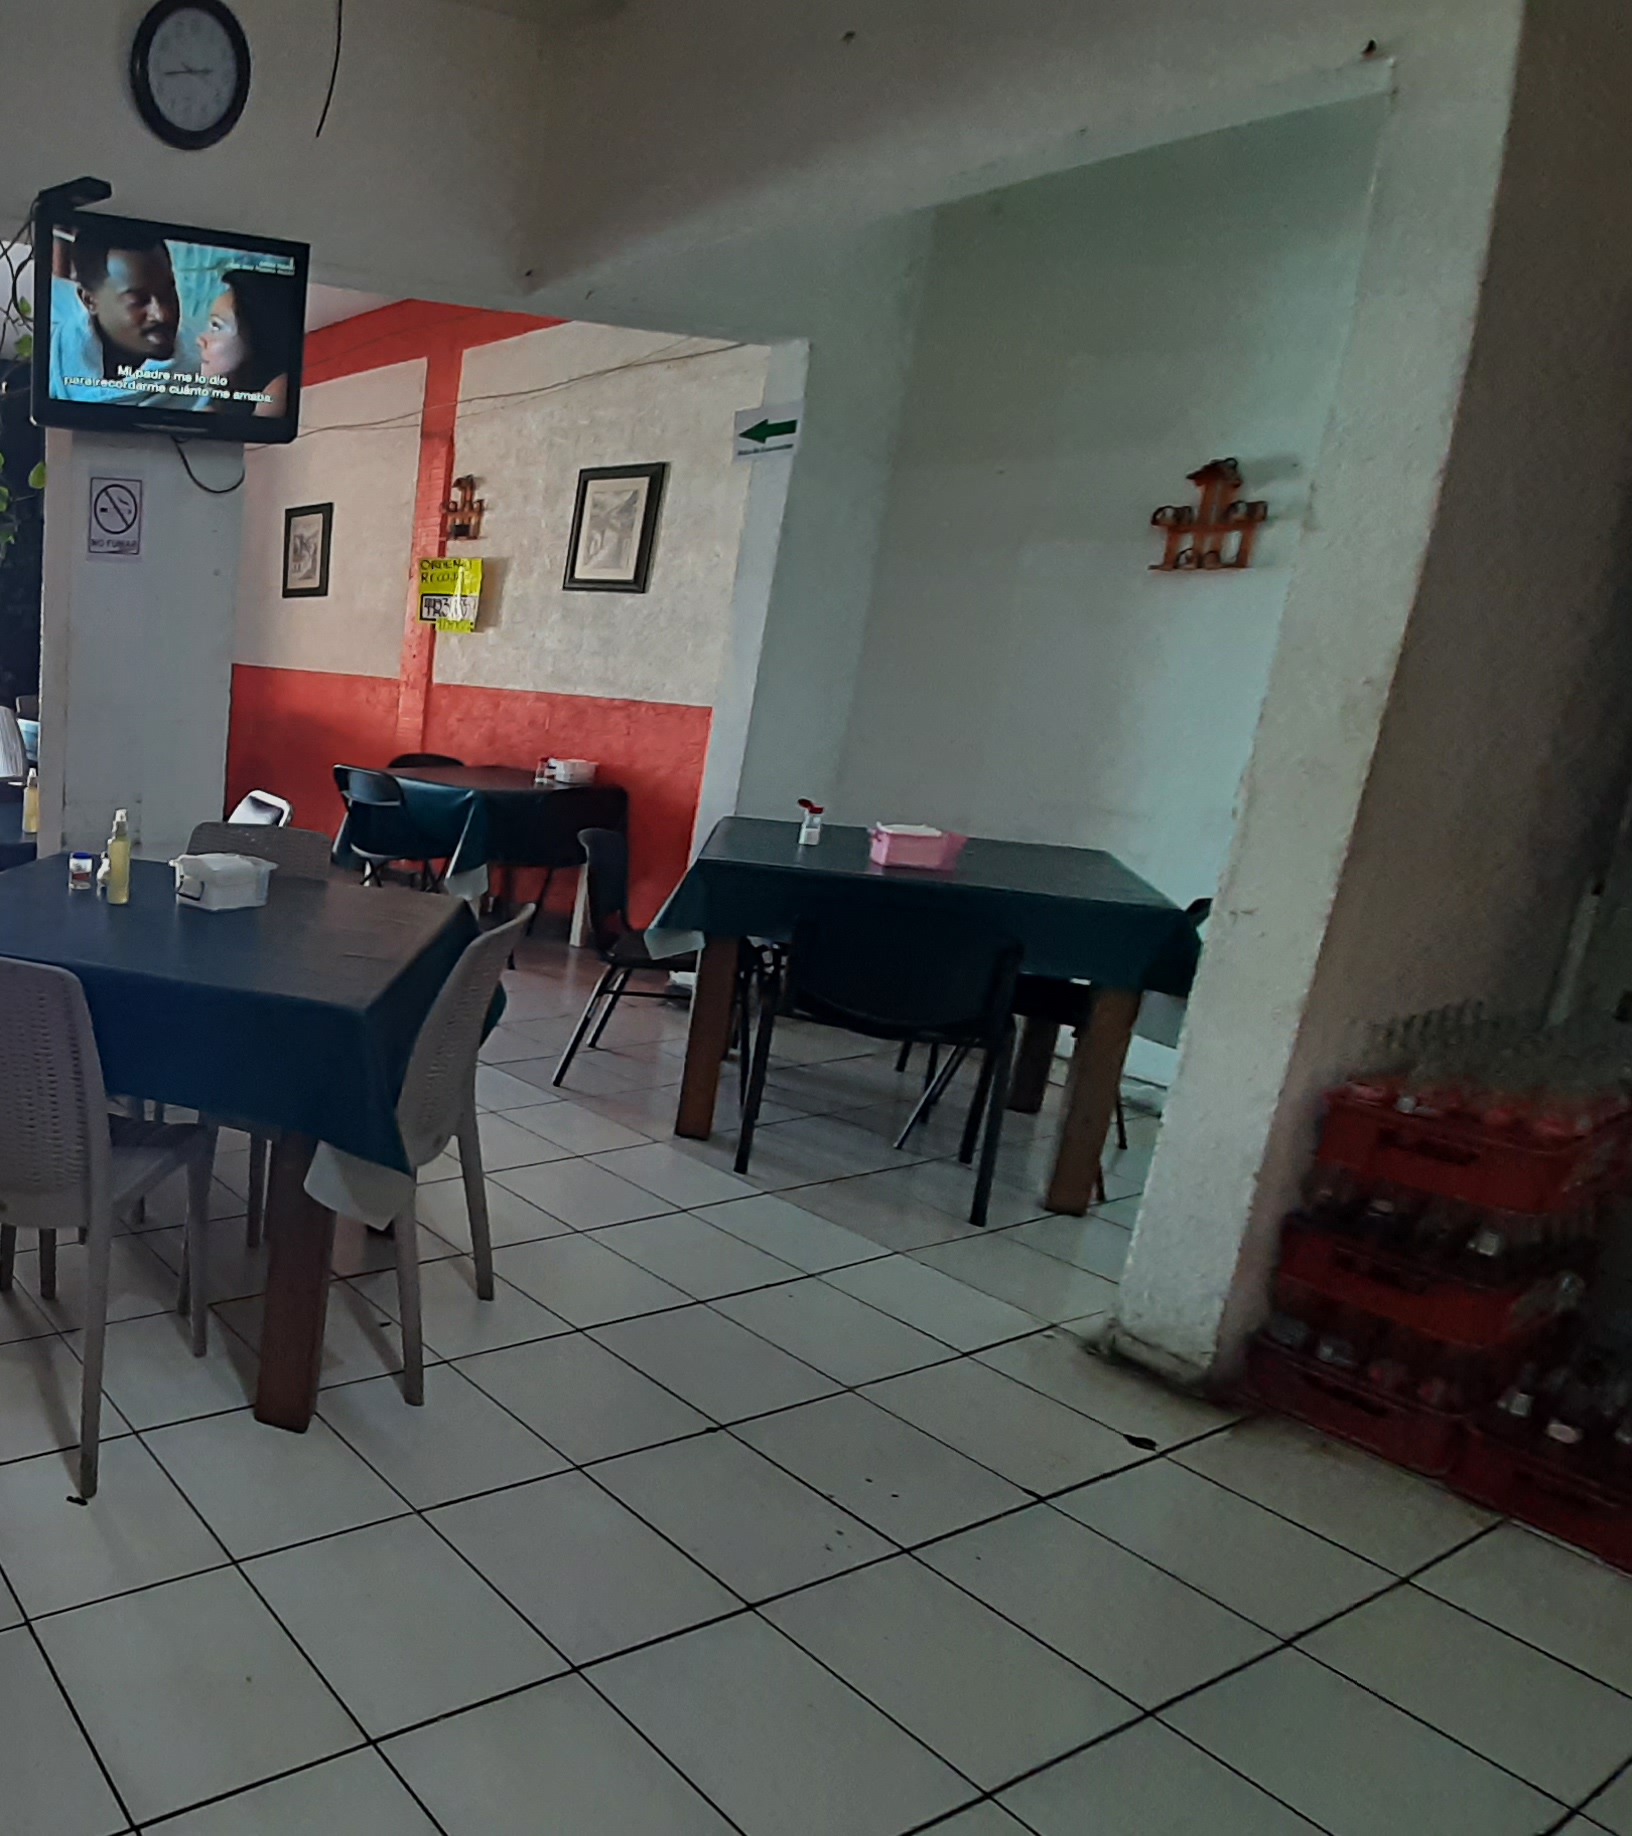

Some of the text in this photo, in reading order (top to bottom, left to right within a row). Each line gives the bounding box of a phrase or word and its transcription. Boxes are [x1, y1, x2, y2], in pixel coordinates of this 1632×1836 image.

[63, 375, 94, 387] para
[94, 377, 167, 394] recordarme
[168, 382, 211, 397] cuánto
[211, 386, 231, 399] me
[134, 368, 171, 382] padre
[173, 372, 192, 384] me
[195, 371, 208, 385] lo
[209, 374, 228, 387] dio
